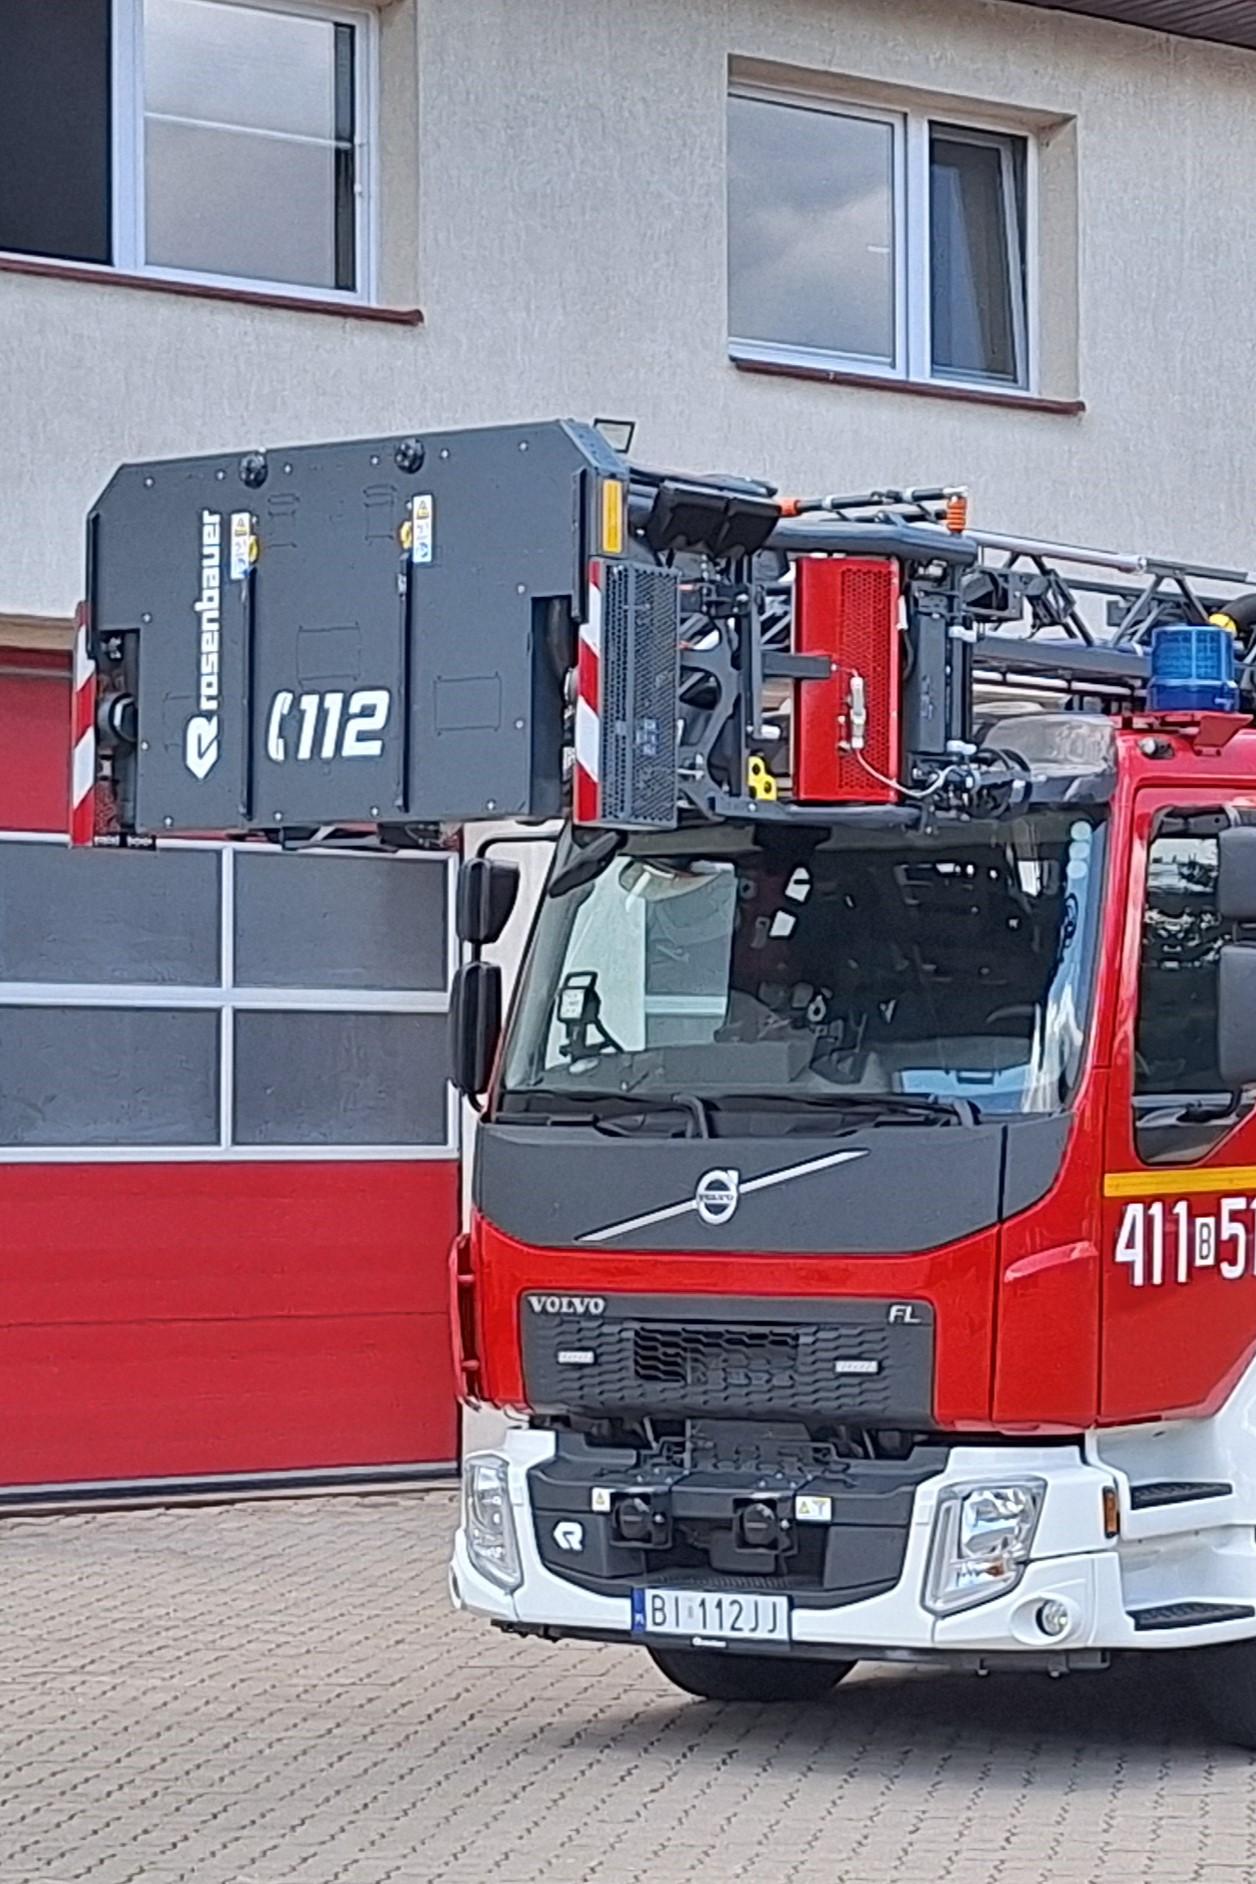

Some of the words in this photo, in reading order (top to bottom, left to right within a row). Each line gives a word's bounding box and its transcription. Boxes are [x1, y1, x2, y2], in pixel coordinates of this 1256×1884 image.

[194, 509, 221, 712] rosenbauer
[297, 689, 391, 760] 112
[527, 1295, 606, 1316] VOLVO
[889, 1304, 921, 1324] FL
